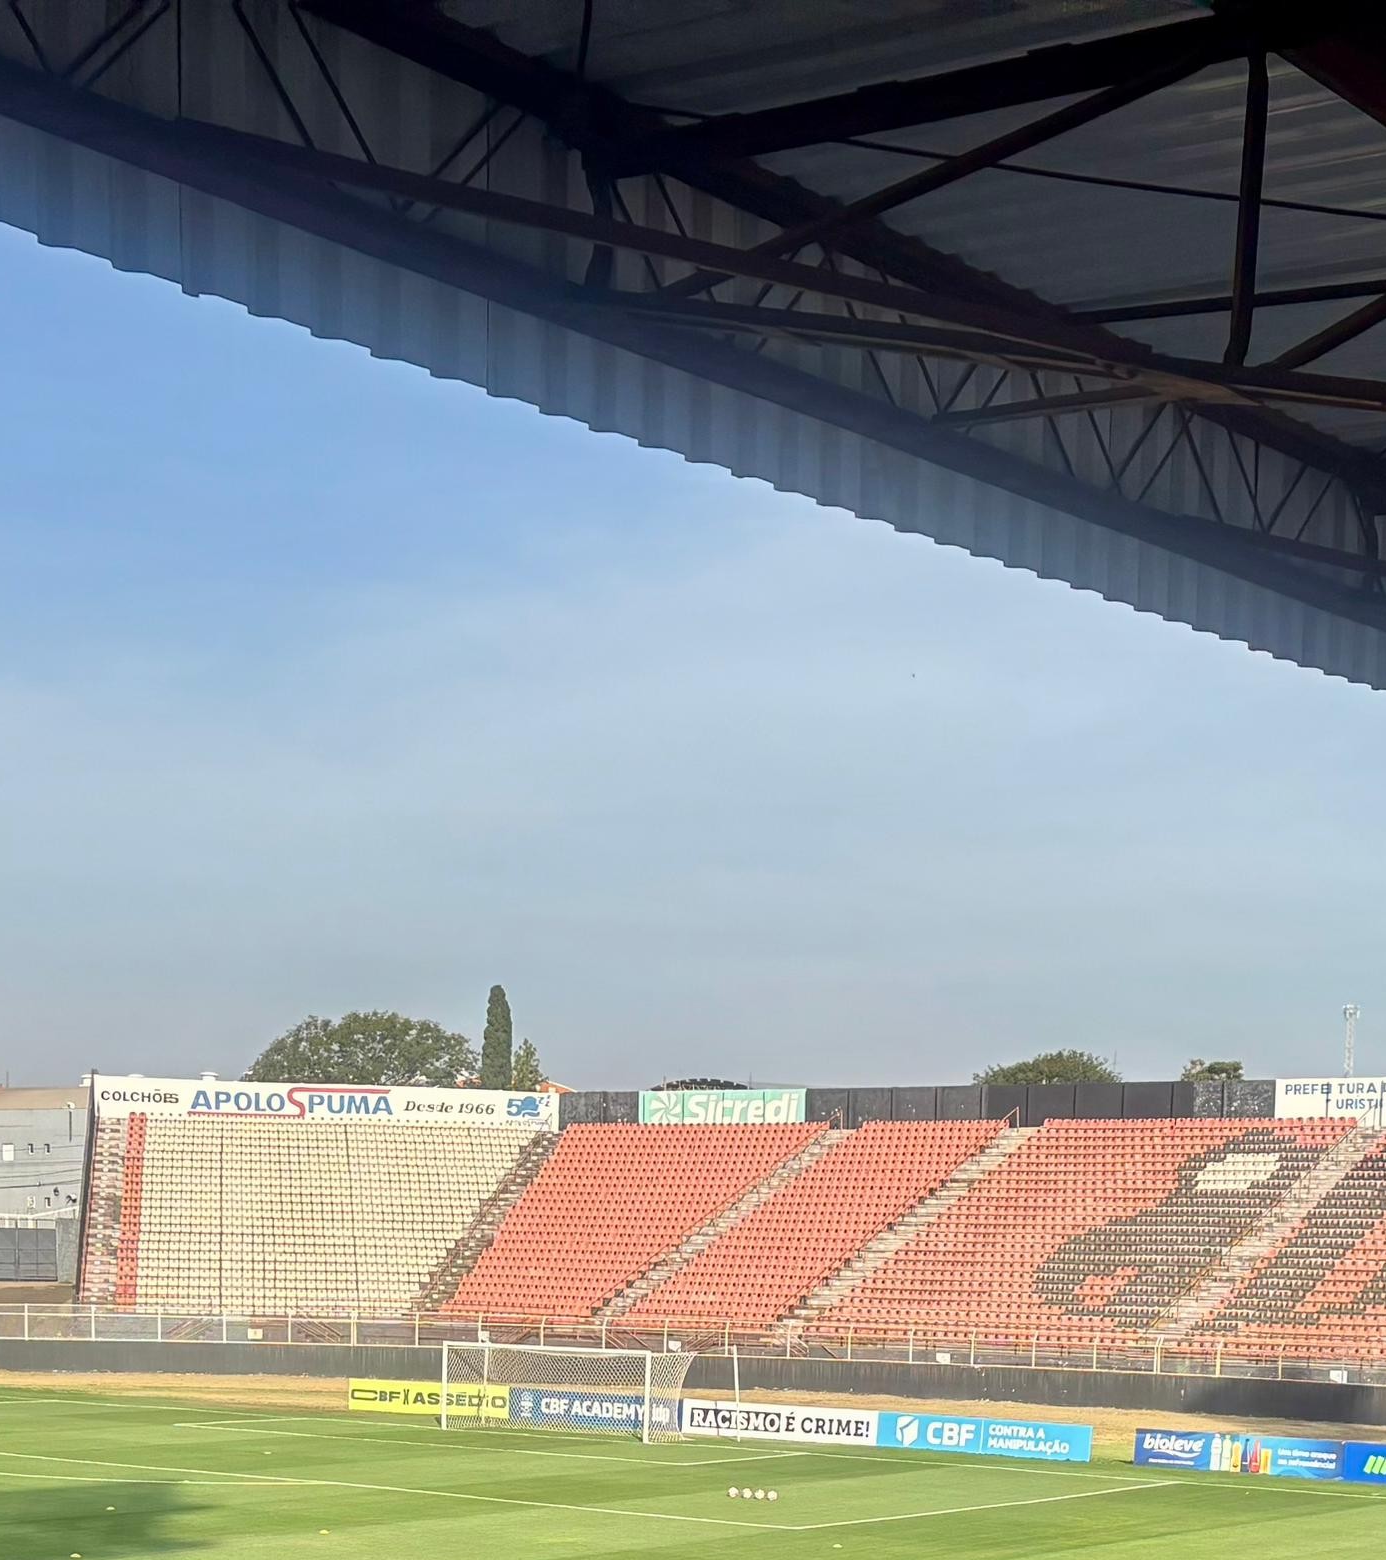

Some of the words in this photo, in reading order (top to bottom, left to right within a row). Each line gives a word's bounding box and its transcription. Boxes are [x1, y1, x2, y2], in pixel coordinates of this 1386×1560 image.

[404, 1100, 454, 1113] Desde
[458, 1102, 496, 1115] 1966
[683, 1093, 800, 1124] Sicredi
[351, 1388, 401, 1403] CBF
[540, 1397, 569, 1416] CBF
[570, 1400, 646, 1422] ACADEMY
[691, 1407, 781, 1433] RACISMO
[785, 1411, 796, 1433] É
[800, 1416, 871, 1438] CRIME!
[926, 1421, 977, 1447] CBF
[987, 1423, 1034, 1438] CONTRA
[1034, 1427, 1046, 1440] A
[1143, 1433, 1206, 1453] bioleve
[986, 1436, 1070, 1456] MANIPULAÇÃO
